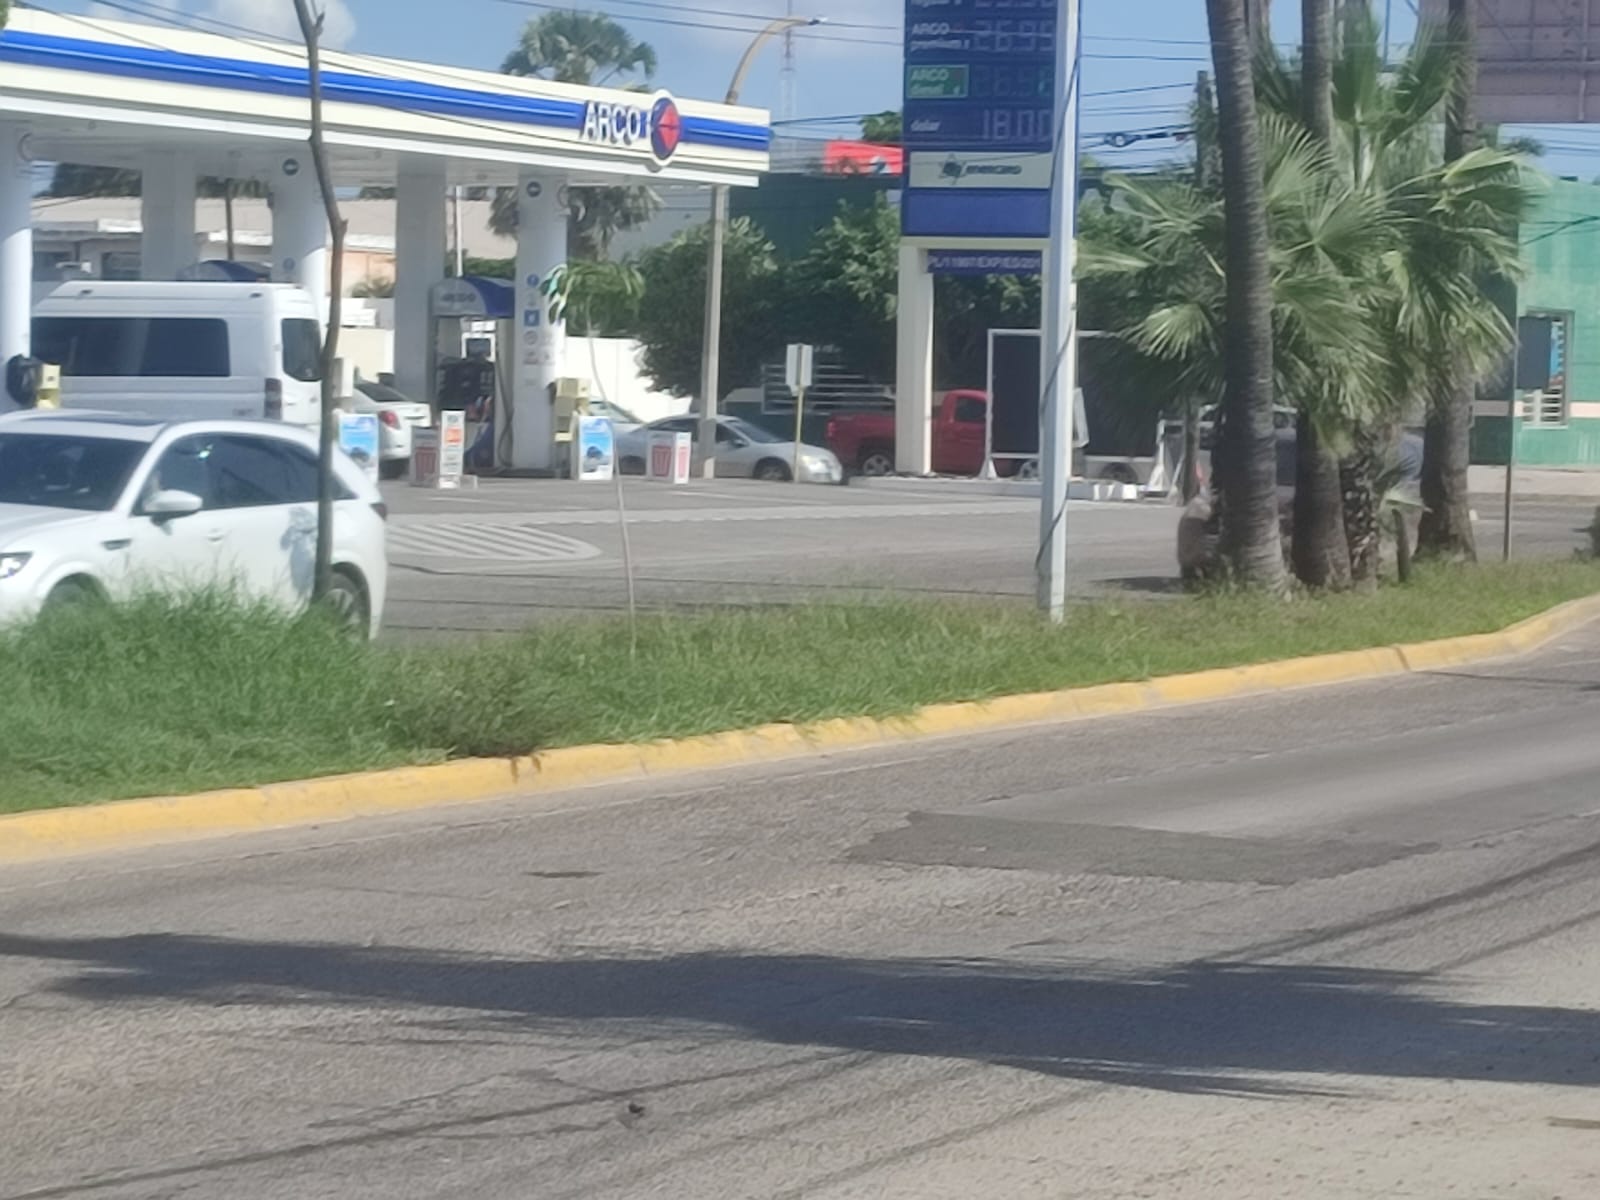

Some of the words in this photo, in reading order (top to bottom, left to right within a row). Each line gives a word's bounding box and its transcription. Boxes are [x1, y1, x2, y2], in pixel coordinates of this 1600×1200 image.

[911, 22, 950, 35] ARCO
[911, 68, 949, 81] ARCO
[584, 101, 641, 141] ARCO
